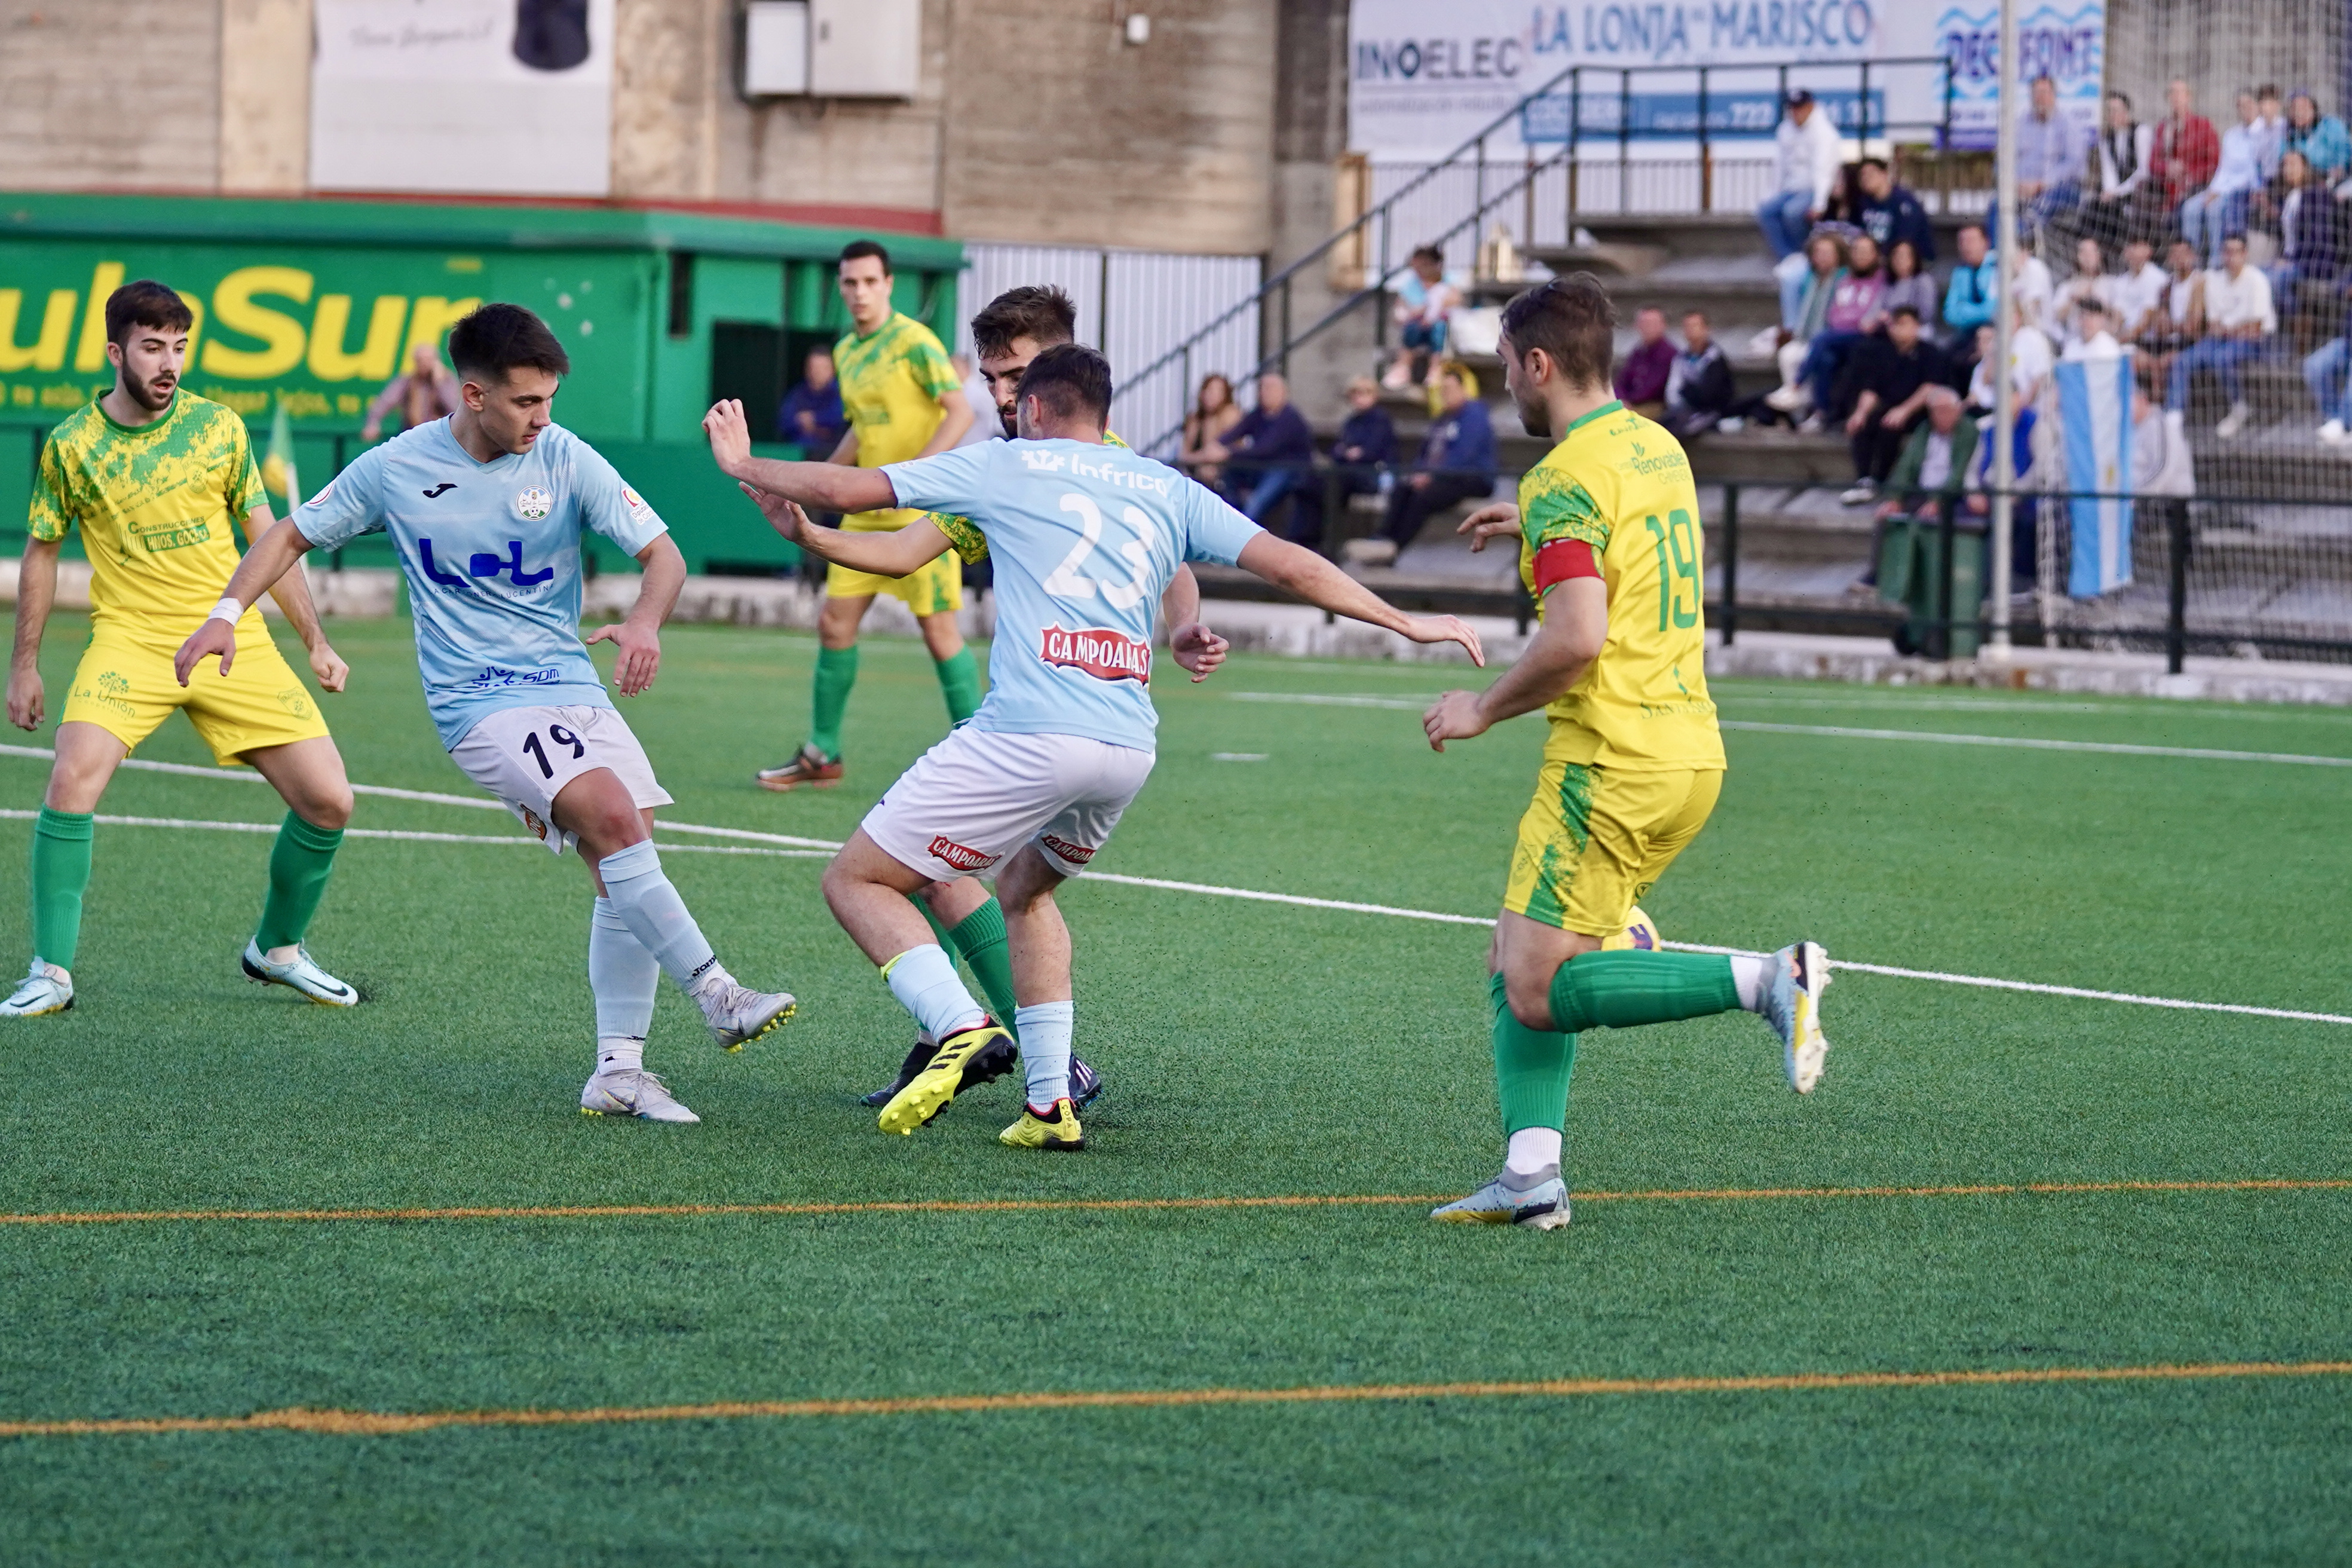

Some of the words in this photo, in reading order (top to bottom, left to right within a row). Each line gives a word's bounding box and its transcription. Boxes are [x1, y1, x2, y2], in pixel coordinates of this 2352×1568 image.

[1357, 37, 1520, 79] INOELEC
[1533, 7, 1571, 53] LA
[1585, 3, 1690, 62] LONJA
[1710, 0, 1874, 47] MARISCO
[0, 261, 483, 381] ulSur
[1043, 493, 1154, 610] 23
[1646, 509, 1700, 632] 19
[74, 685, 91, 697] La
[98, 690, 135, 718] Unión
[523, 724, 584, 779] 19
[1062, 1104, 1073, 1128] COPA
